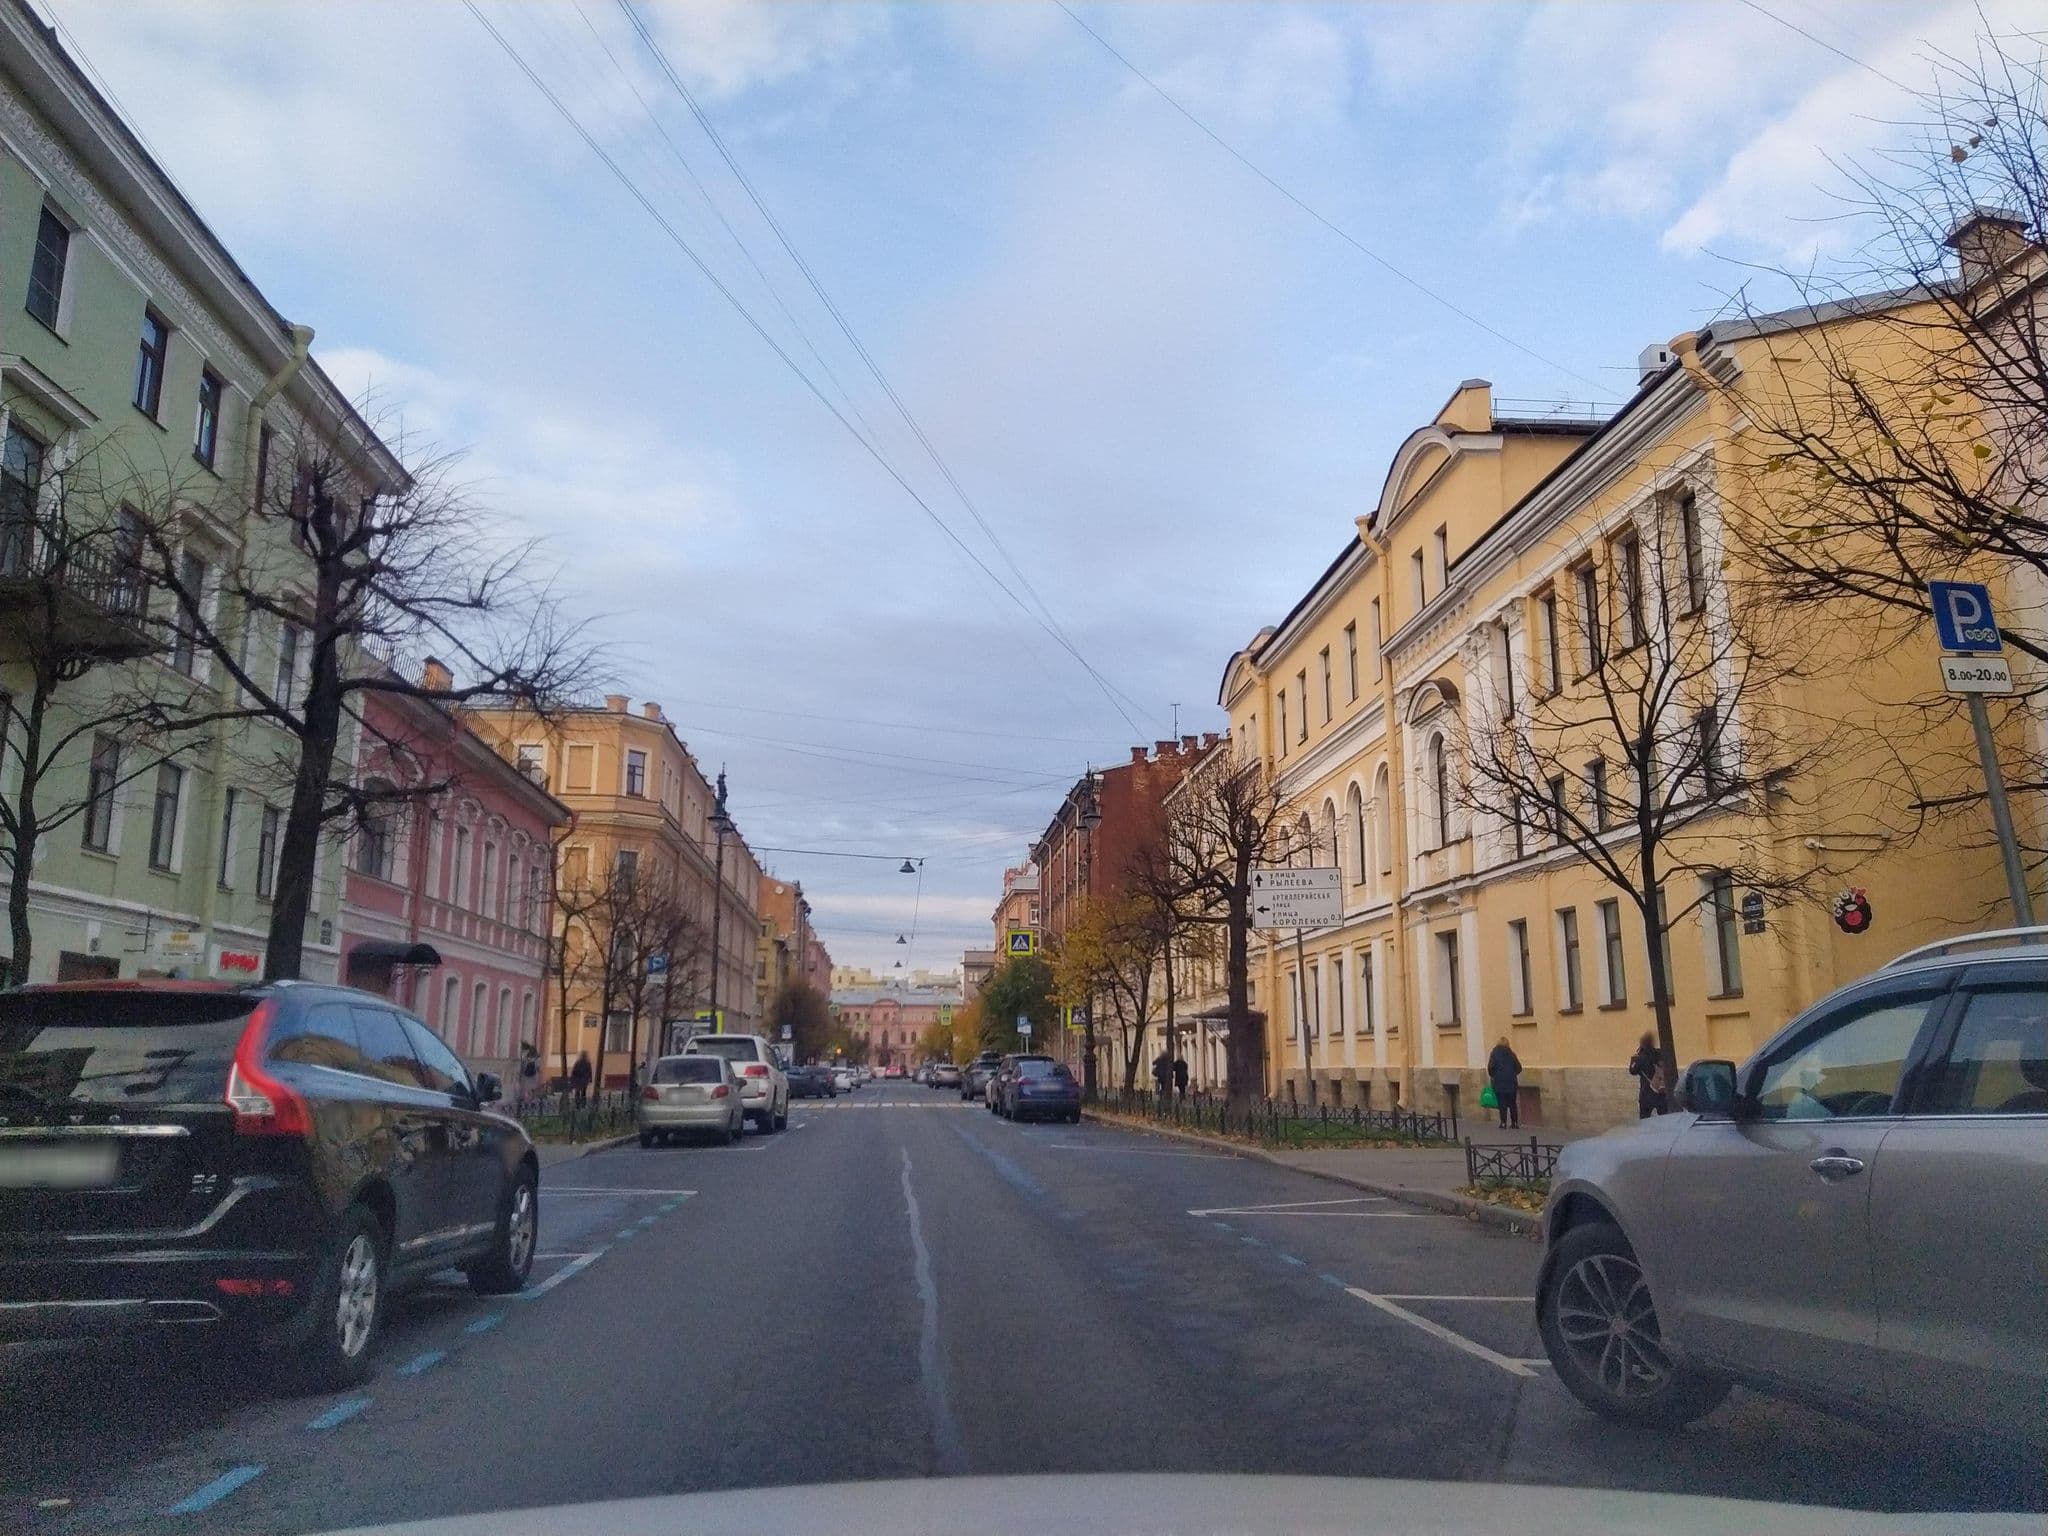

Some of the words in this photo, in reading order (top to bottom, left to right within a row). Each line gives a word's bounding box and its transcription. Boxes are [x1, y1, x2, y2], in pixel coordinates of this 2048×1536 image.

[1947, 668, 2007, 681] 8.00-20.00
[1270, 872, 1296, 880] улица
[1270, 879, 1314, 887] РЫЛЕЕВА
[1272, 918, 1329, 926] КОРОЛЕНКО
